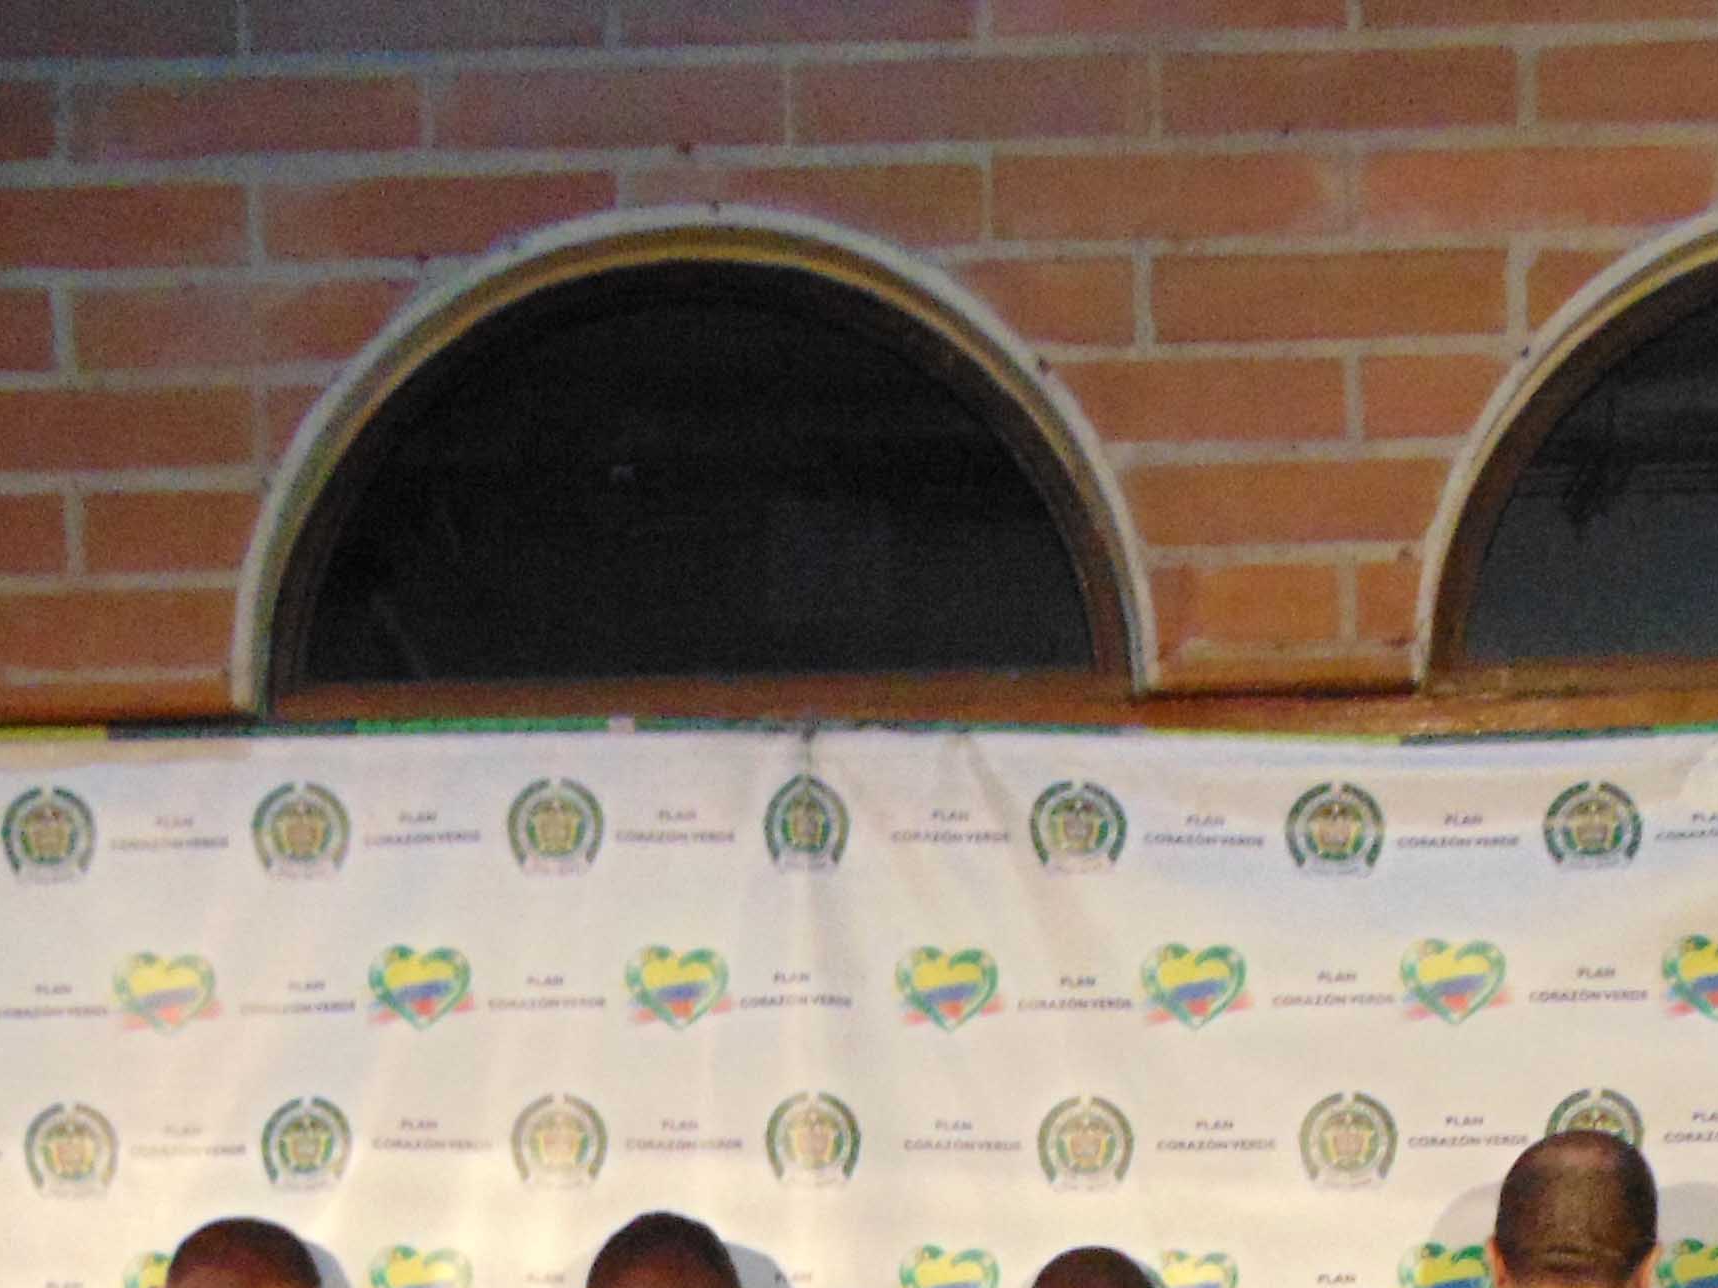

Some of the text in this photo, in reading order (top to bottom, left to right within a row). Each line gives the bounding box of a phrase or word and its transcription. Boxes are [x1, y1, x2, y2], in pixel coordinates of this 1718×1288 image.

[1317, 969, 1358, 984] PLAN
[1576, 966, 1616, 980] PLAN
[1059, 975, 1096, 988] PLAN
[1351, 992, 1396, 1006] VERDE
[1605, 987, 1649, 1003] VERDE
[1091, 996, 1133, 1010] VERDE
[1316, 1273, 1358, 1286] PLAN
